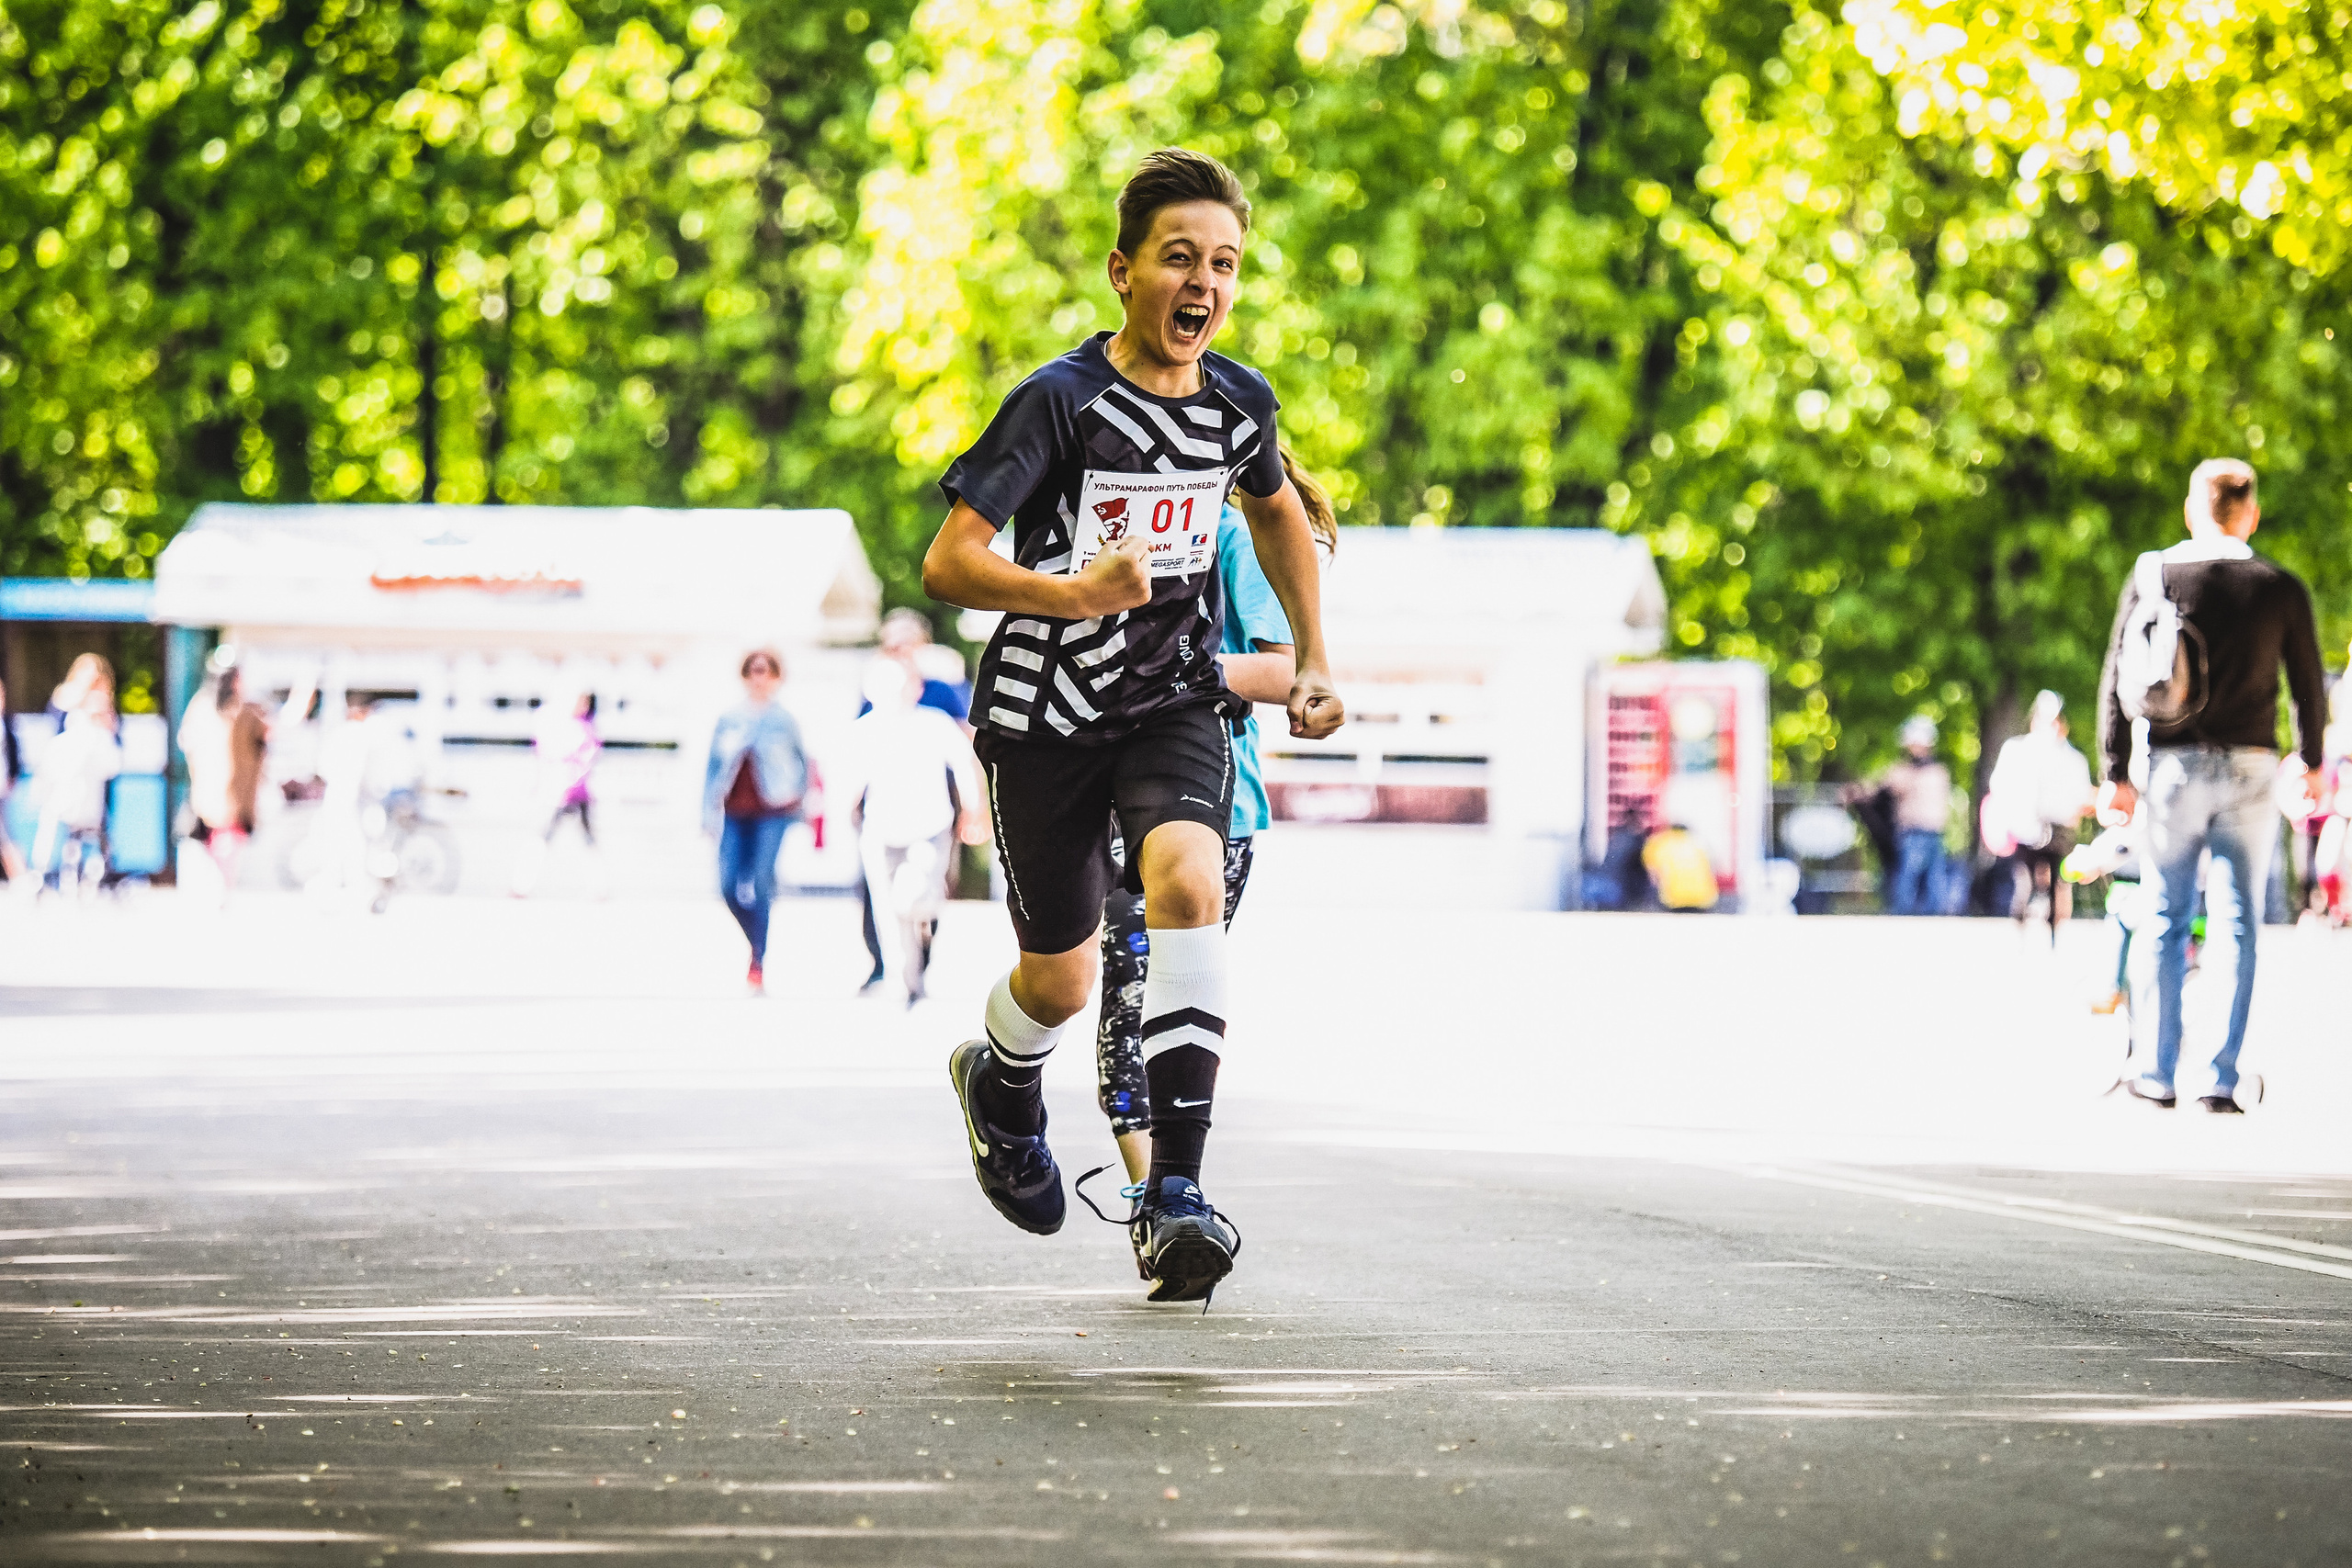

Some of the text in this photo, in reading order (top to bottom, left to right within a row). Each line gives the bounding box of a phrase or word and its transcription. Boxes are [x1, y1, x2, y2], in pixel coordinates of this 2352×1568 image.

[1093, 480, 1217, 492] УЛЬТРАМАРАФОН ПУТЬ ПОБЕДЫ
[1151, 497, 1194, 534] 01
